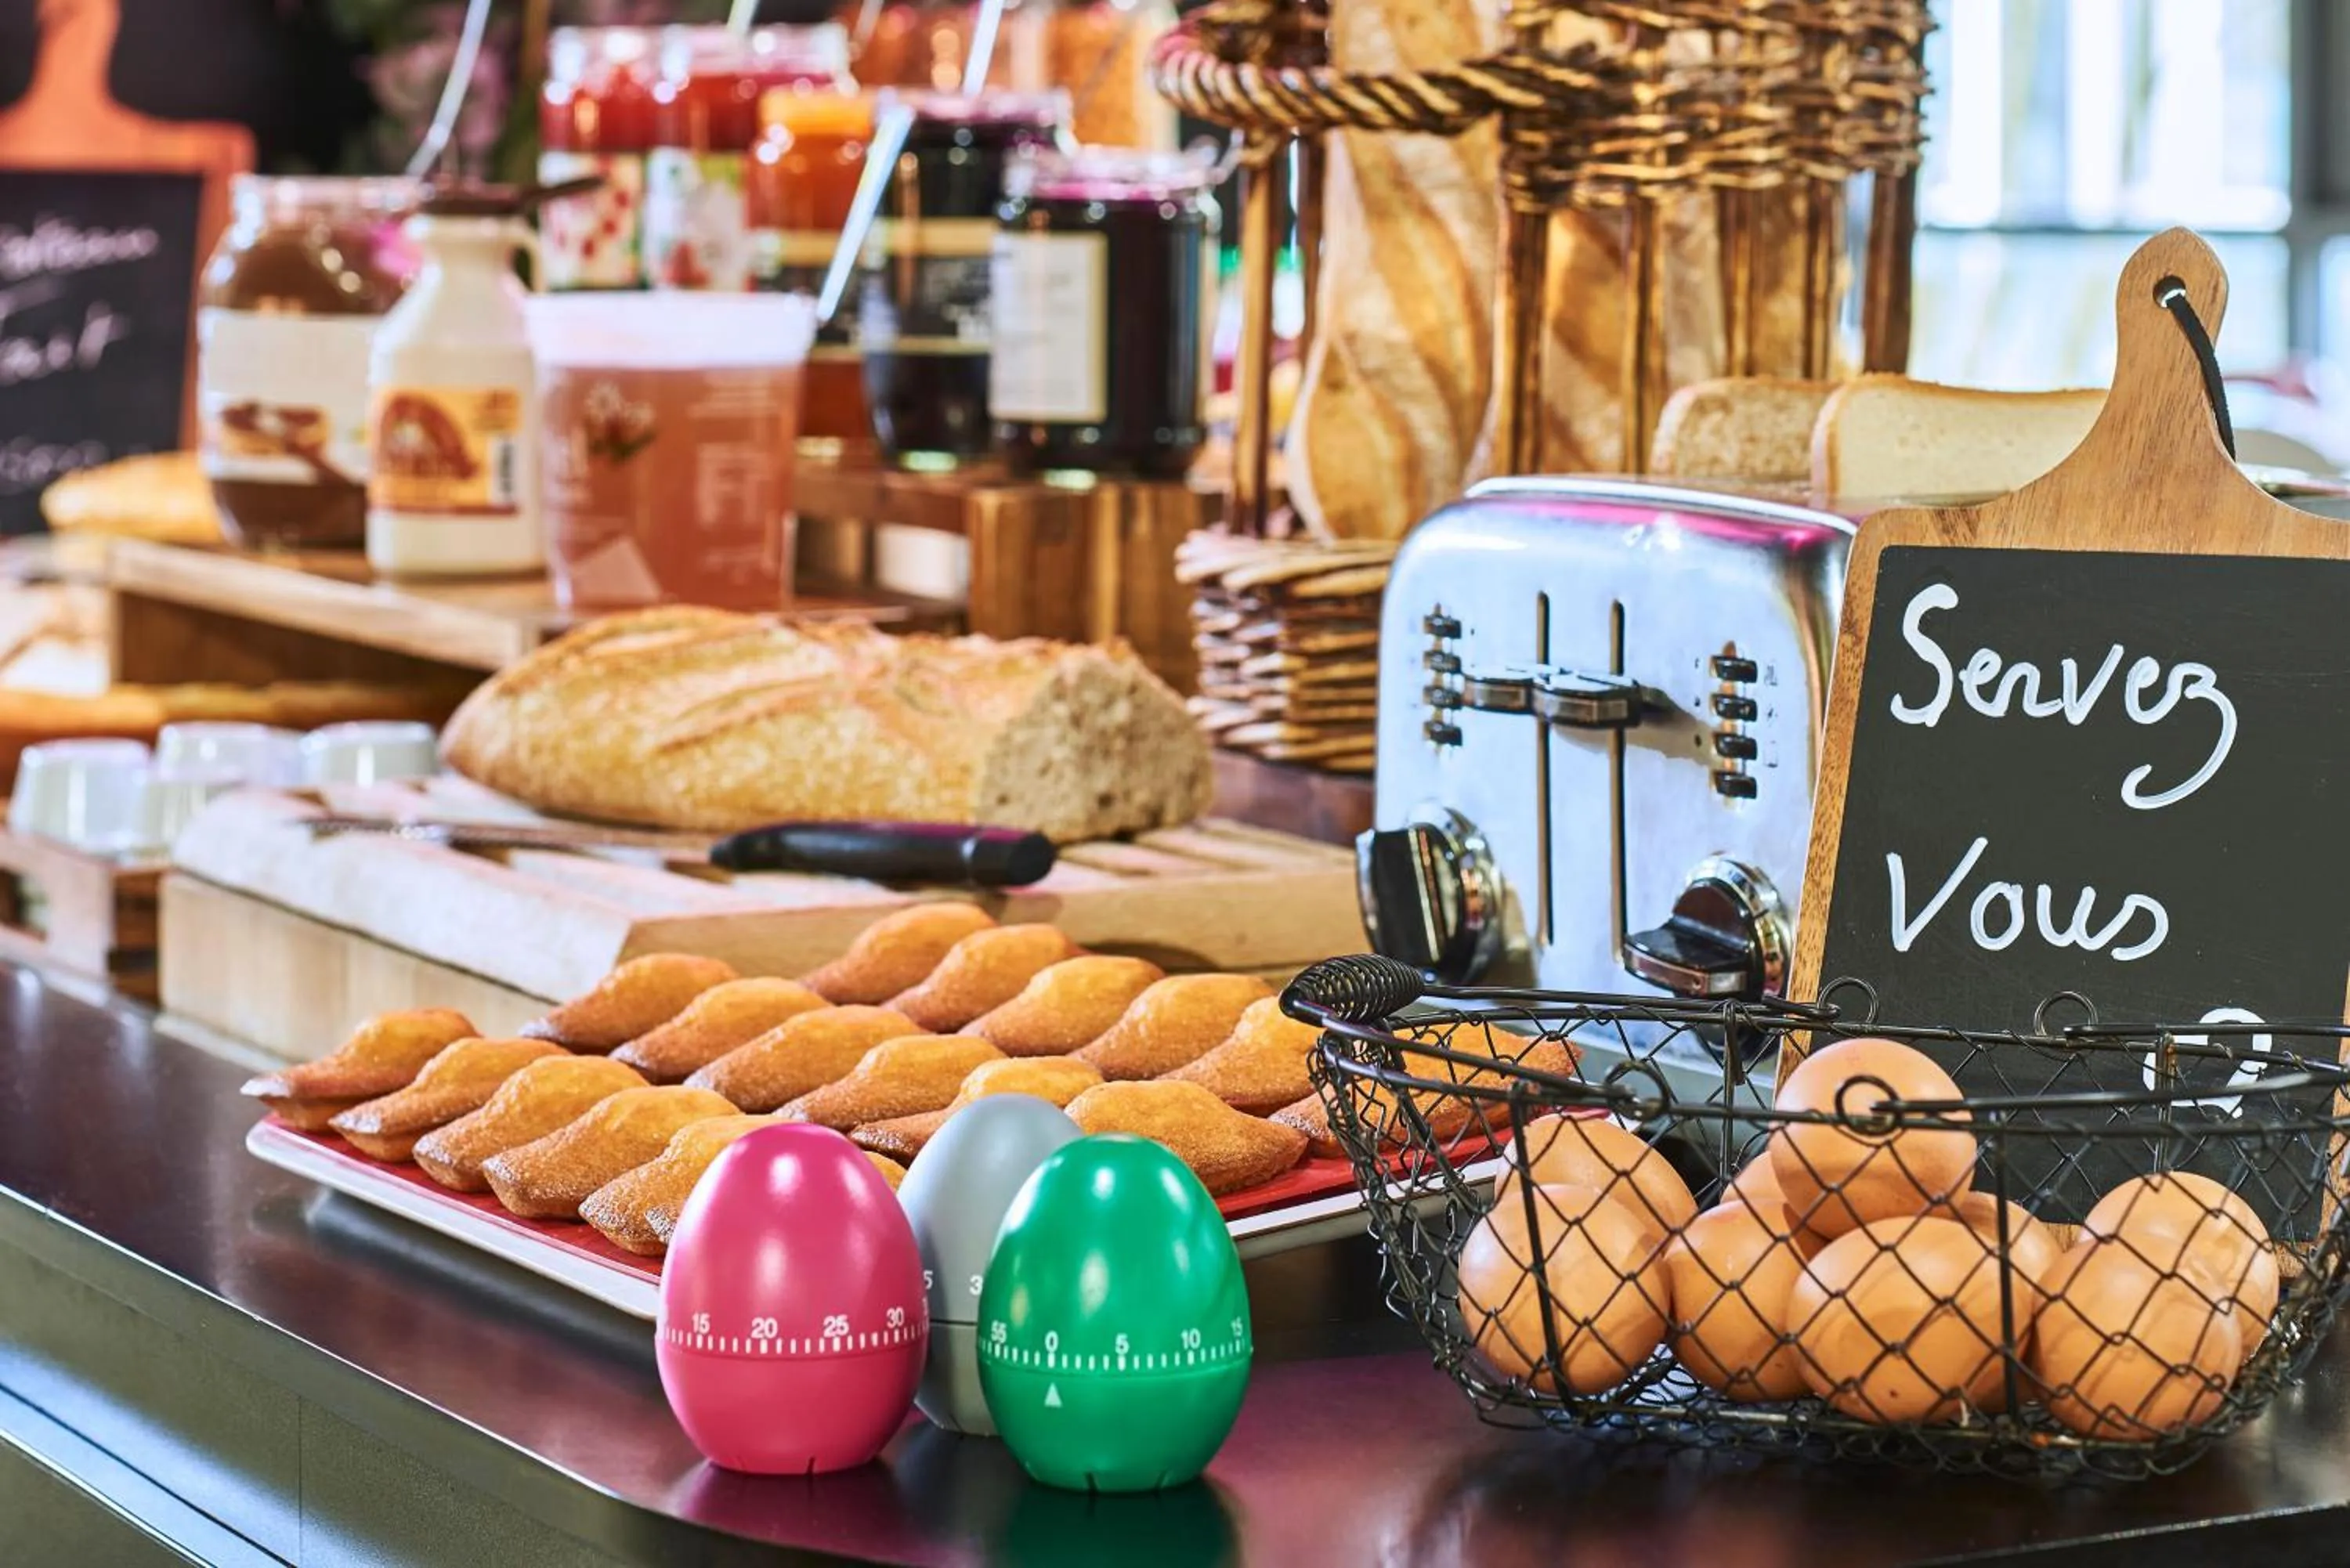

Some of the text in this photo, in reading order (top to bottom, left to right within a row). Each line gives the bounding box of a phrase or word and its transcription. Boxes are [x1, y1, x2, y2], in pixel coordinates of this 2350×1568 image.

[1891, 583, 2237, 810] Servez
[1885, 836, 2169, 961] Vous
[923, 1270, 983, 1295] 5 3
[692, 1313, 710, 1334] 15
[751, 1317, 778, 1339] 20
[823, 1314, 849, 1337] 25
[886, 1306, 904, 1328] 30
[991, 1317, 1242, 1354] 55 0 5 10 15
